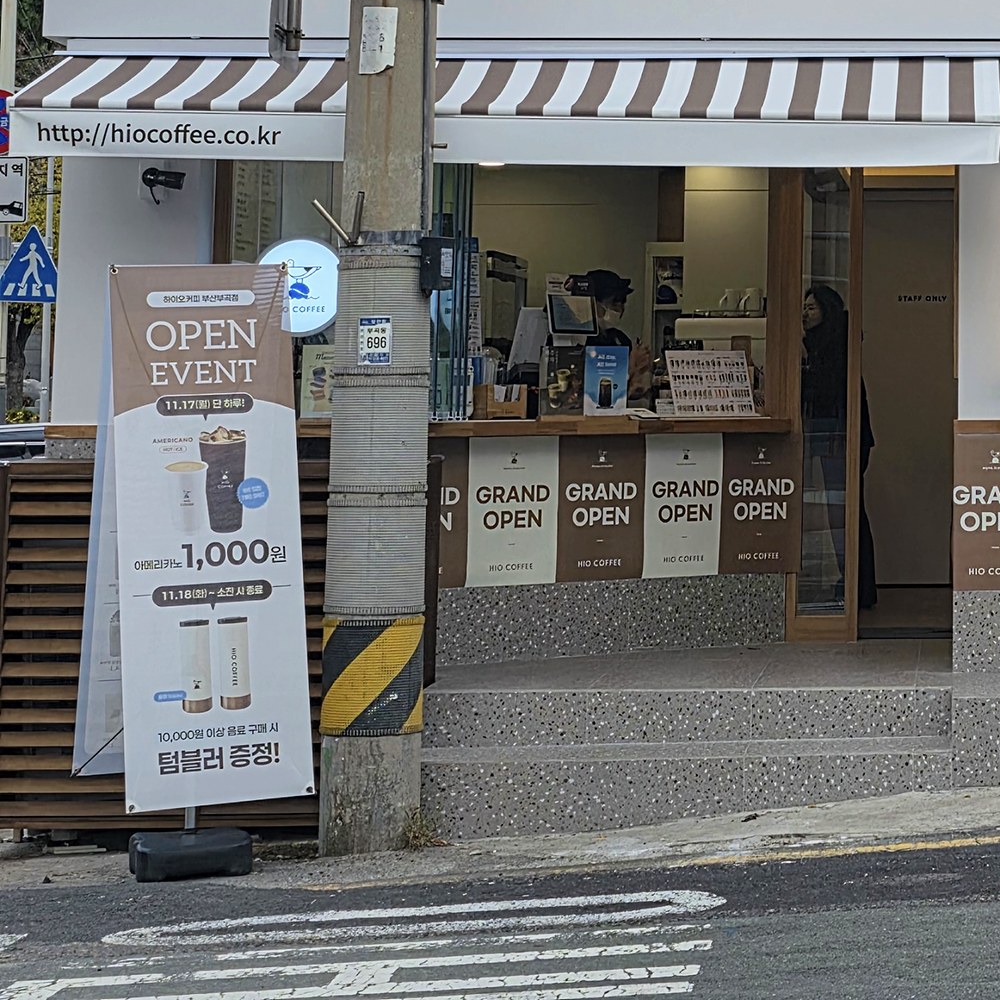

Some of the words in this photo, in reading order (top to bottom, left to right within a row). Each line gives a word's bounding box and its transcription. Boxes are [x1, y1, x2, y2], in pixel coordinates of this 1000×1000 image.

[36, 121, 282, 148] http://hiocoffee.co.kr
[146, 319, 258, 351] OPEN
[366, 336, 387, 349] 696
[150, 360, 258, 386] EVENT
[476, 484, 551, 504] GRAND
[565, 481, 638, 502] GRAND
[652, 479, 720, 498] GRAND
[728, 478, 795, 497] GRAND
[483, 509, 543, 530] OPEN
[572, 505, 630, 527] OPEN
[658, 503, 713, 523] OPEN
[733, 501, 788, 521] OPEN
[134, 559, 182, 571] 아메리카노
[206, 727, 226, 739] 이상
[227, 725, 247, 736] 음료
[248, 724, 268, 735] 구매
[269, 722, 279, 733] 시
[158, 746, 225, 775] 텀블러
[229, 742, 280, 769] 증정!
